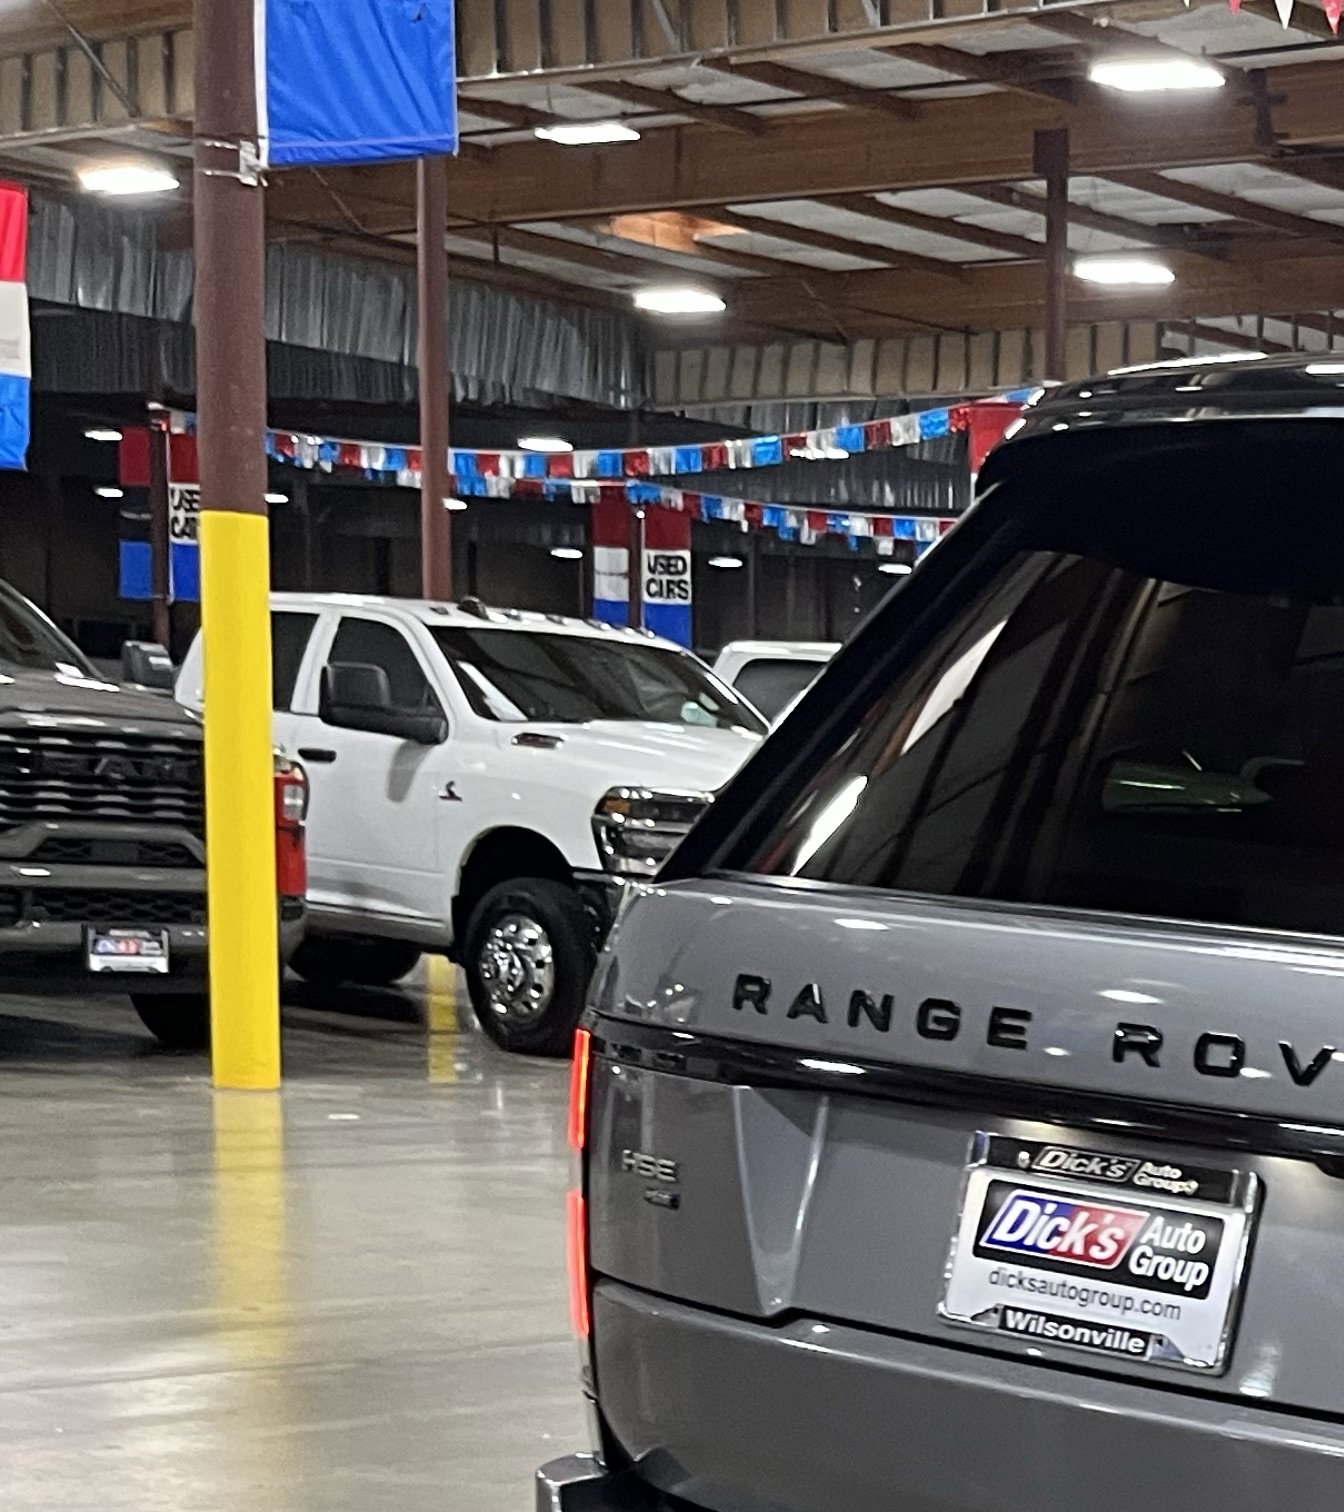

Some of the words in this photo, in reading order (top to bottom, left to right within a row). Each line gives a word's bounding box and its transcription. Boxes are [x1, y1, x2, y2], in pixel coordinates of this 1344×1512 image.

[170, 487, 200, 511] USE
[170, 516, 200, 538] CA
[647, 553, 687, 575] USED
[732, 973, 1033, 1051] RANGE
[622, 1149, 676, 1182] HSE
[1039, 1149, 1129, 1179] Dick's
[1142, 1162, 1182, 1179] Auto
[992, 1195, 1126, 1261] Dick's
[1140, 1216, 1206, 1254] Auto
[1128, 1245, 1209, 1291] Group
[988, 1266, 1181, 1320] dicksautogroup.com
[1005, 1309, 1147, 1354] Wilsonville
